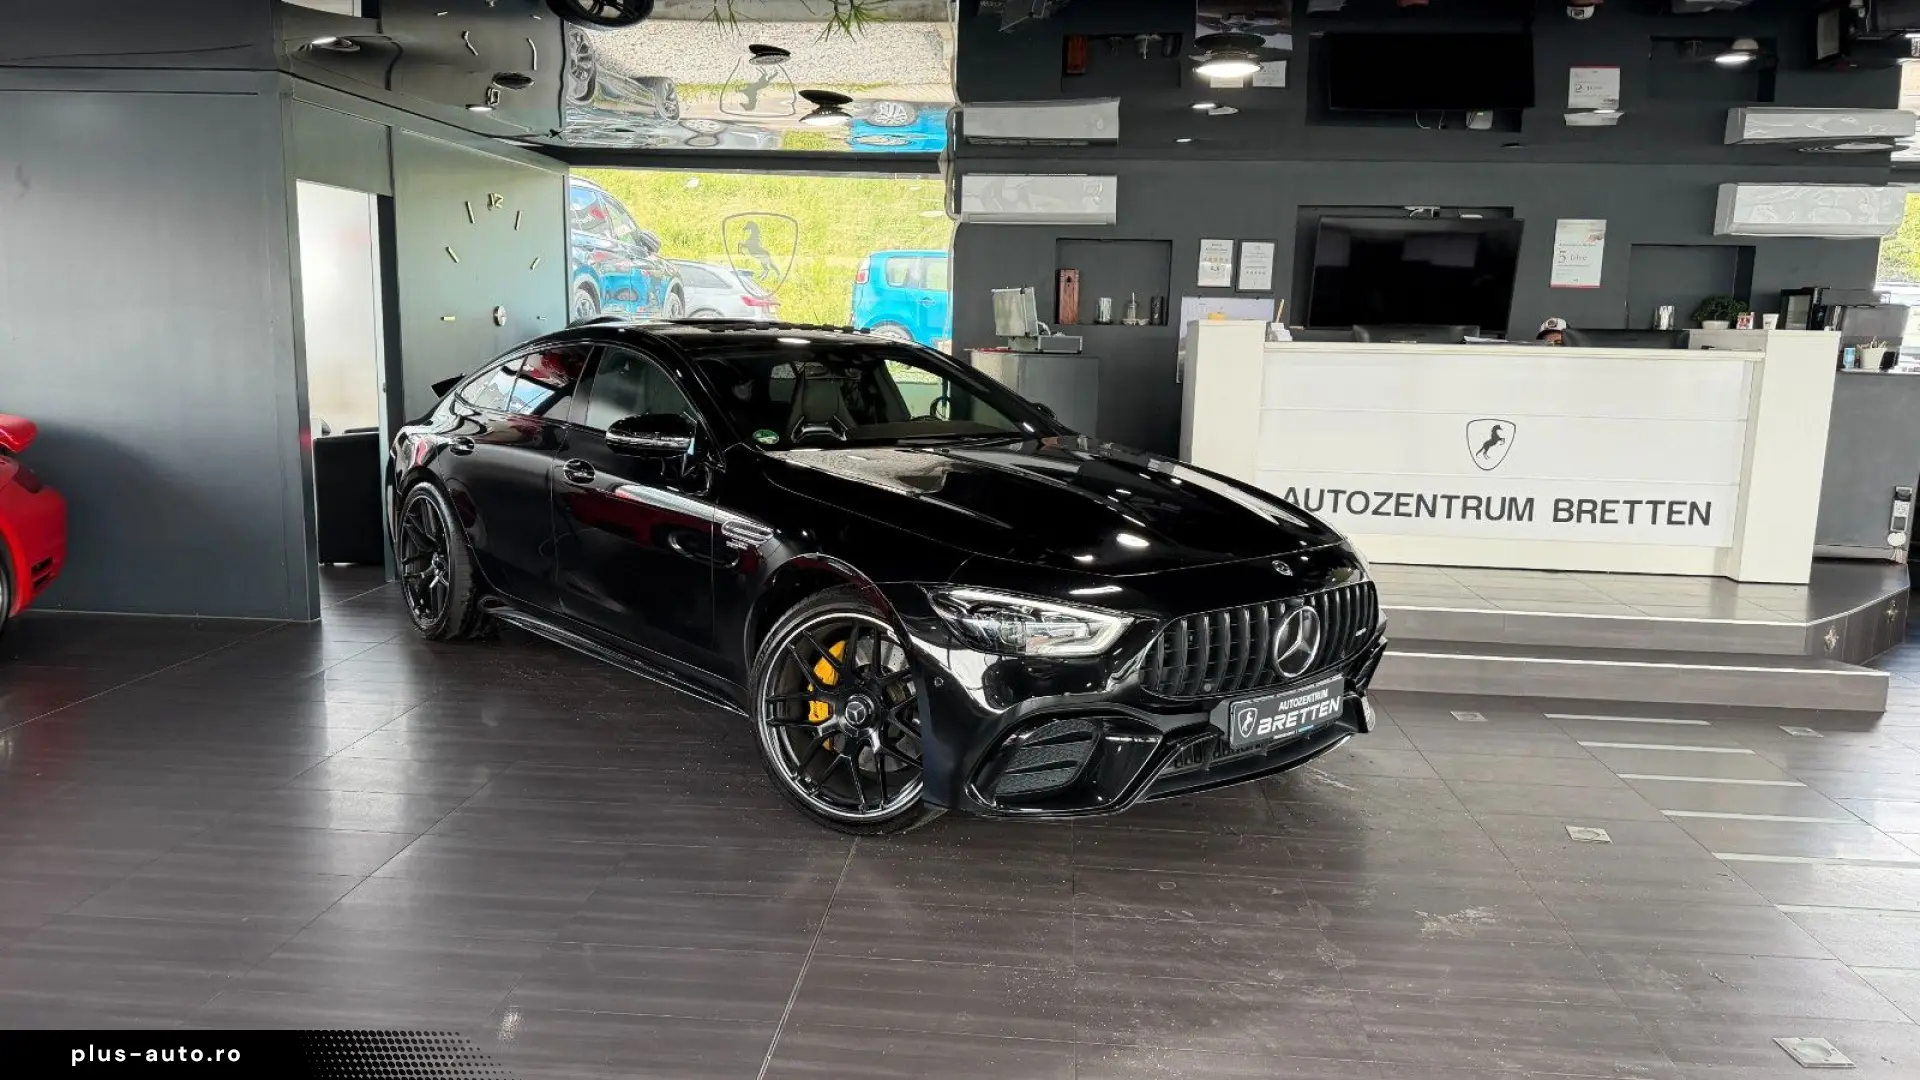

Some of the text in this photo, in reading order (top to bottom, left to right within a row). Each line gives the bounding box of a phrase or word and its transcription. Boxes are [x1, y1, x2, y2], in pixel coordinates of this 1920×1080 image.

[1283, 486, 1712, 526] AUTOZENTRUM BRETTEN
[1257, 695, 1340, 735] BRETTEN
[1278, 688, 1328, 711] AUTOZENTRUM
